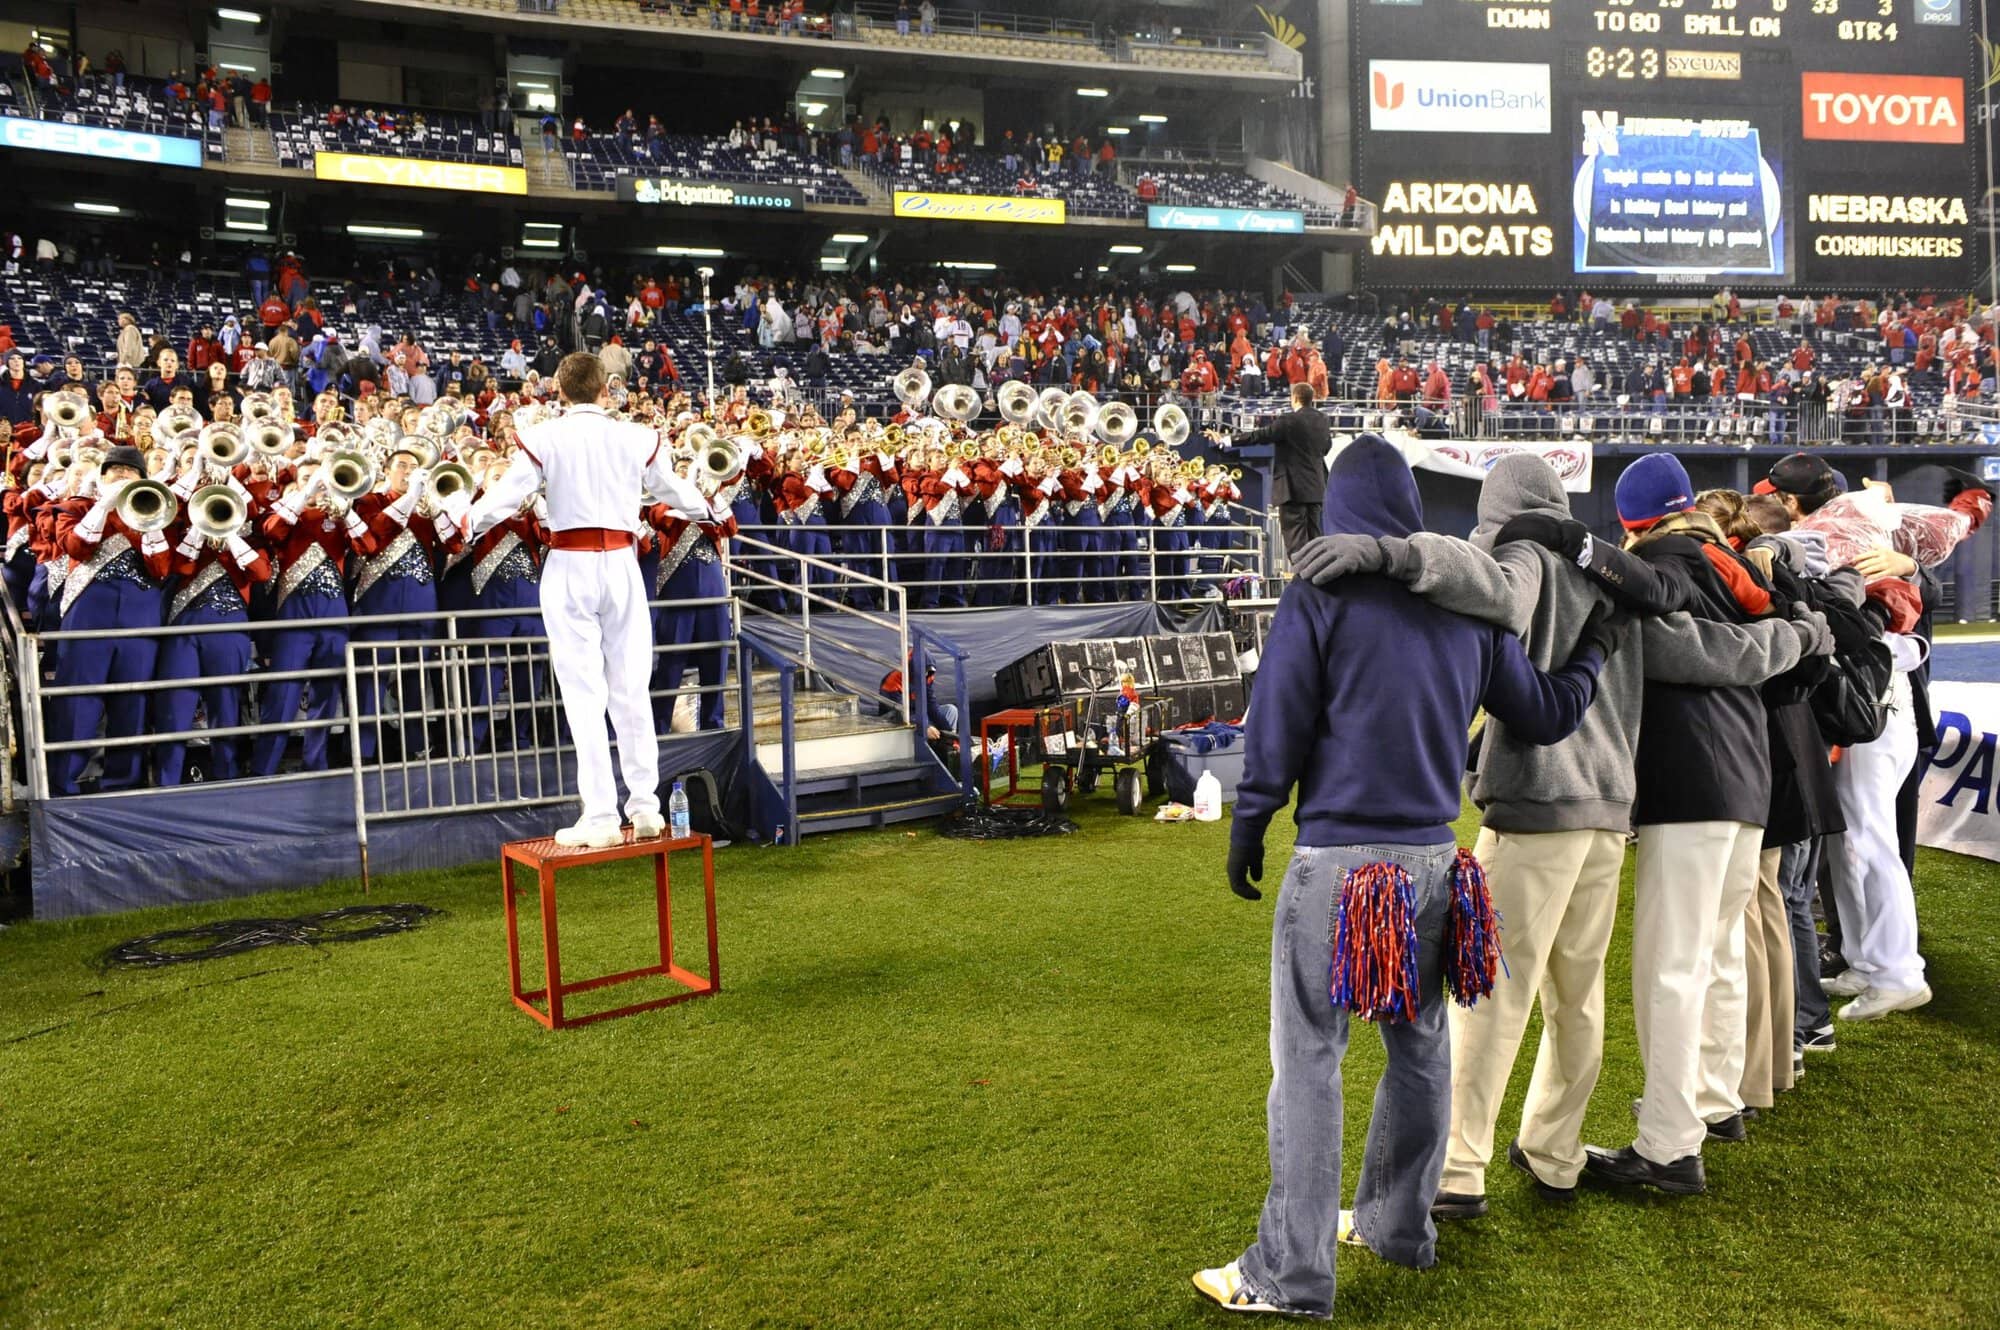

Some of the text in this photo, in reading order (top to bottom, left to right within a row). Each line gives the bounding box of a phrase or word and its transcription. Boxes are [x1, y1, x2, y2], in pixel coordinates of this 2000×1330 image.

[1488, 7, 1549, 29] DOWN
[1594, 11, 1625, 31] TO
[1684, 14, 1781, 37] BALL ON
[1923, 12, 1952, 23] pepsi
[1587, 46, 1658, 79] 8:23
[1667, 55, 1739, 71] SYCUAN
[1809, 92, 1958, 127] TOYOTA
[6, 119, 161, 162] GEICO
[340, 156, 505, 191] CYMER
[660, 179, 792, 207] Brigantine SEAFOOD
[1382, 182, 1538, 214] ARIZONA
[1808, 194, 1969, 224] NEBRASKA
[1370, 225, 1554, 256] WILDCATS
[1815, 235, 1963, 258] CORNHUSKERS
